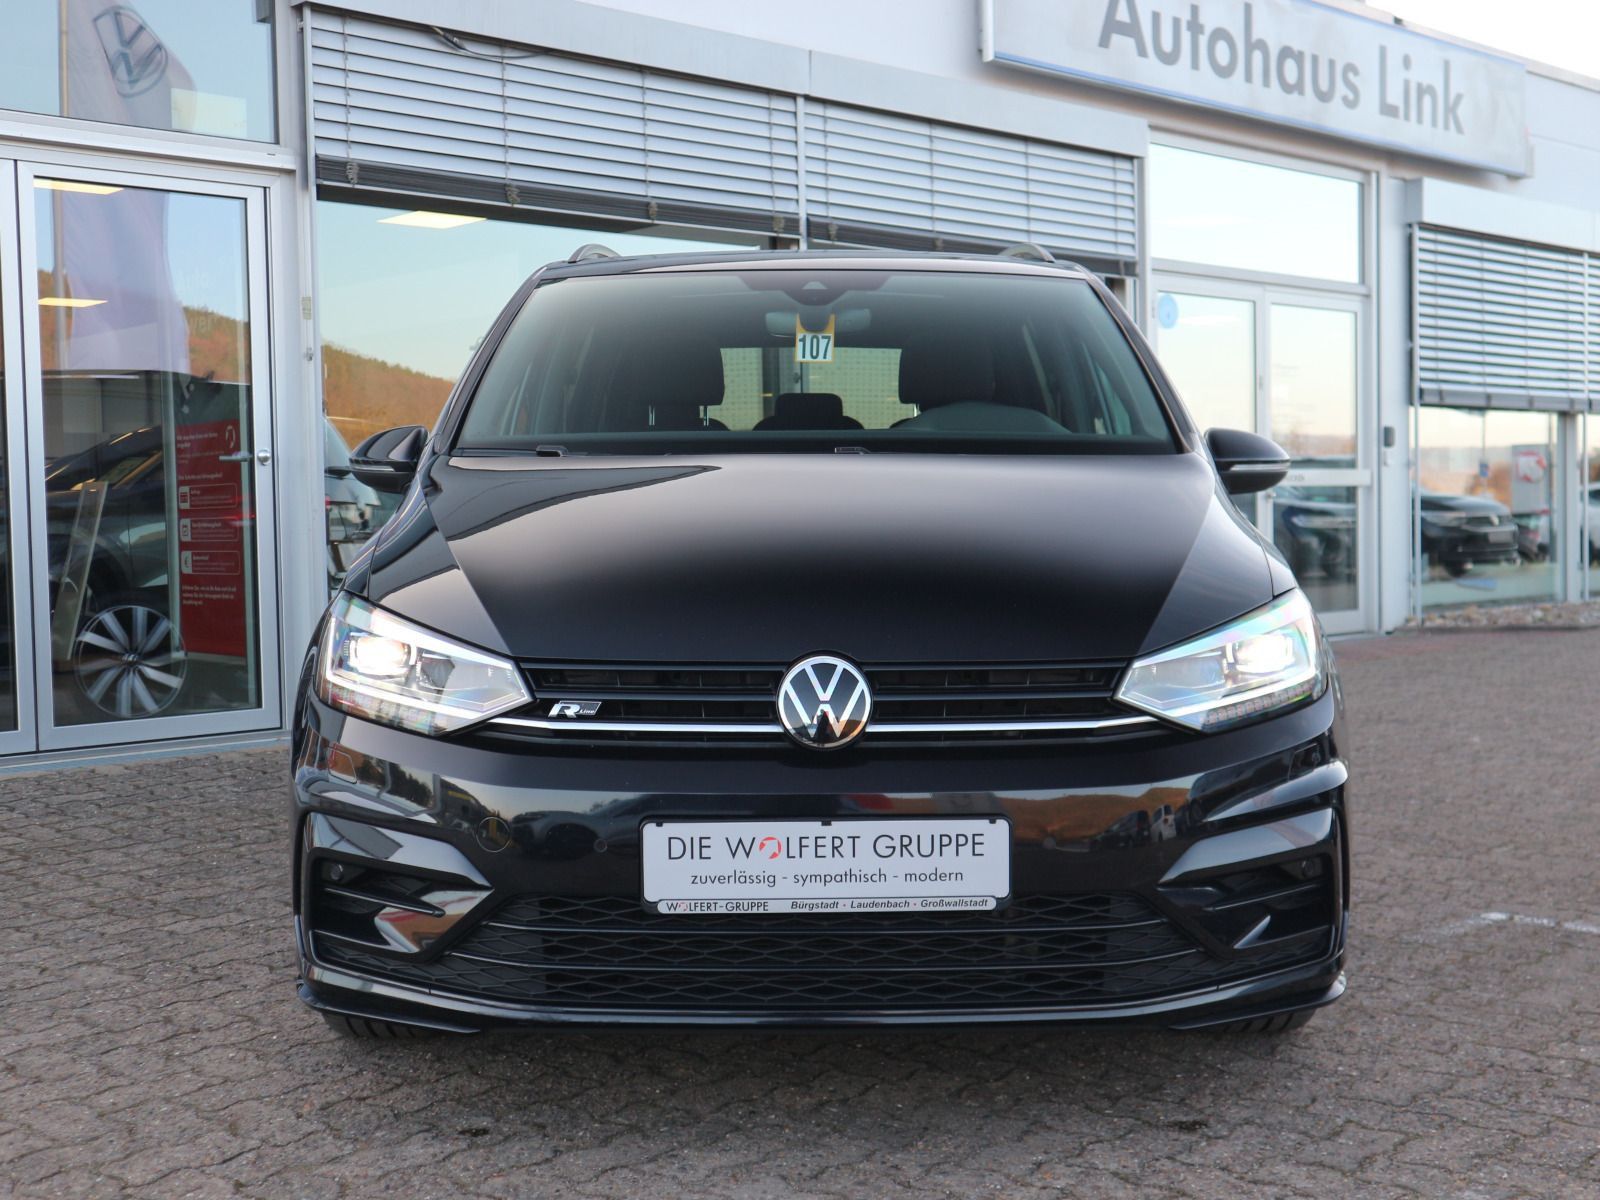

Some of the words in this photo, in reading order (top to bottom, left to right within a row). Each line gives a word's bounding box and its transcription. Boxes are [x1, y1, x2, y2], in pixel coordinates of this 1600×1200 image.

[1098, 0, 1361, 110] Autohaus
[1379, 44, 1465, 135] Link
[799, 334, 831, 360] 107
[547, 703, 581, 718] R
[667, 836, 712, 860] DIE
[725, 836, 861, 860] WOLFERT
[872, 833, 985, 859] GRUPPE
[690, 869, 777, 888] zuverlässig
[793, 867, 887, 885] sympathisch
[904, 868, 964, 883] modern
[790, 901, 839, 911] Bürgstadt
[850, 899, 910, 909] Laudenbach
[920, 898, 988, 909] Großwallstadt
